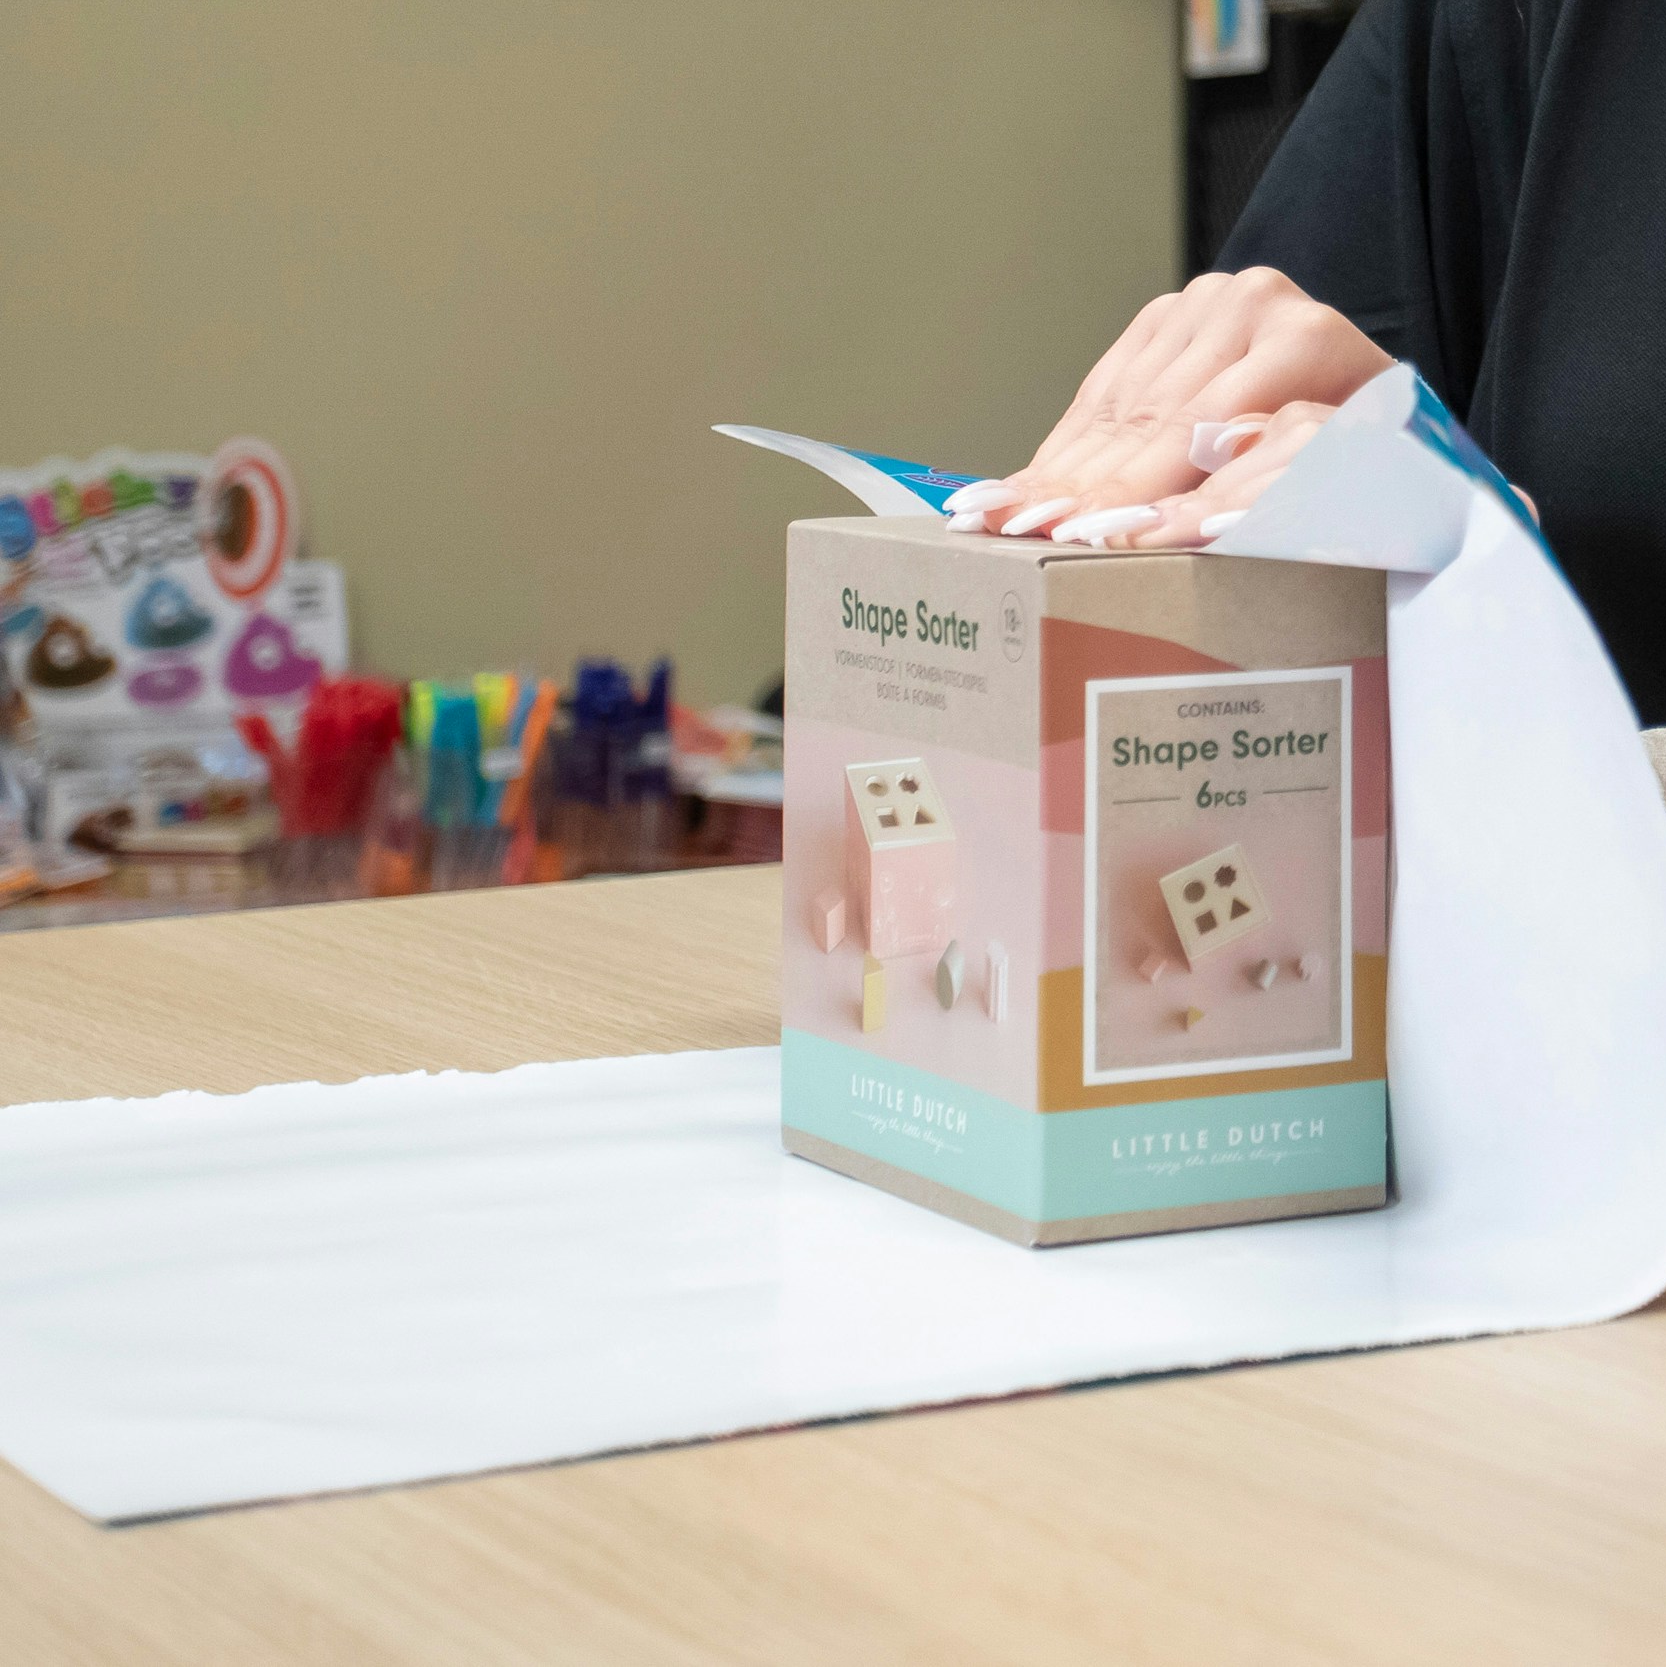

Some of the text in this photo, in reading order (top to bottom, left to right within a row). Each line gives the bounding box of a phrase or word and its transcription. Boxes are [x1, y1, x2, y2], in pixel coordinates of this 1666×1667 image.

[842, 587, 979, 652] Shape Sorter
[1177, 700, 1265, 718] CONTAINS:
[1112, 729, 1328, 771] Shape Sorter
[851, 1073, 967, 1136] LITTLE DUTCH
[1112, 1118, 1324, 1159] LITTLE DUTCH
